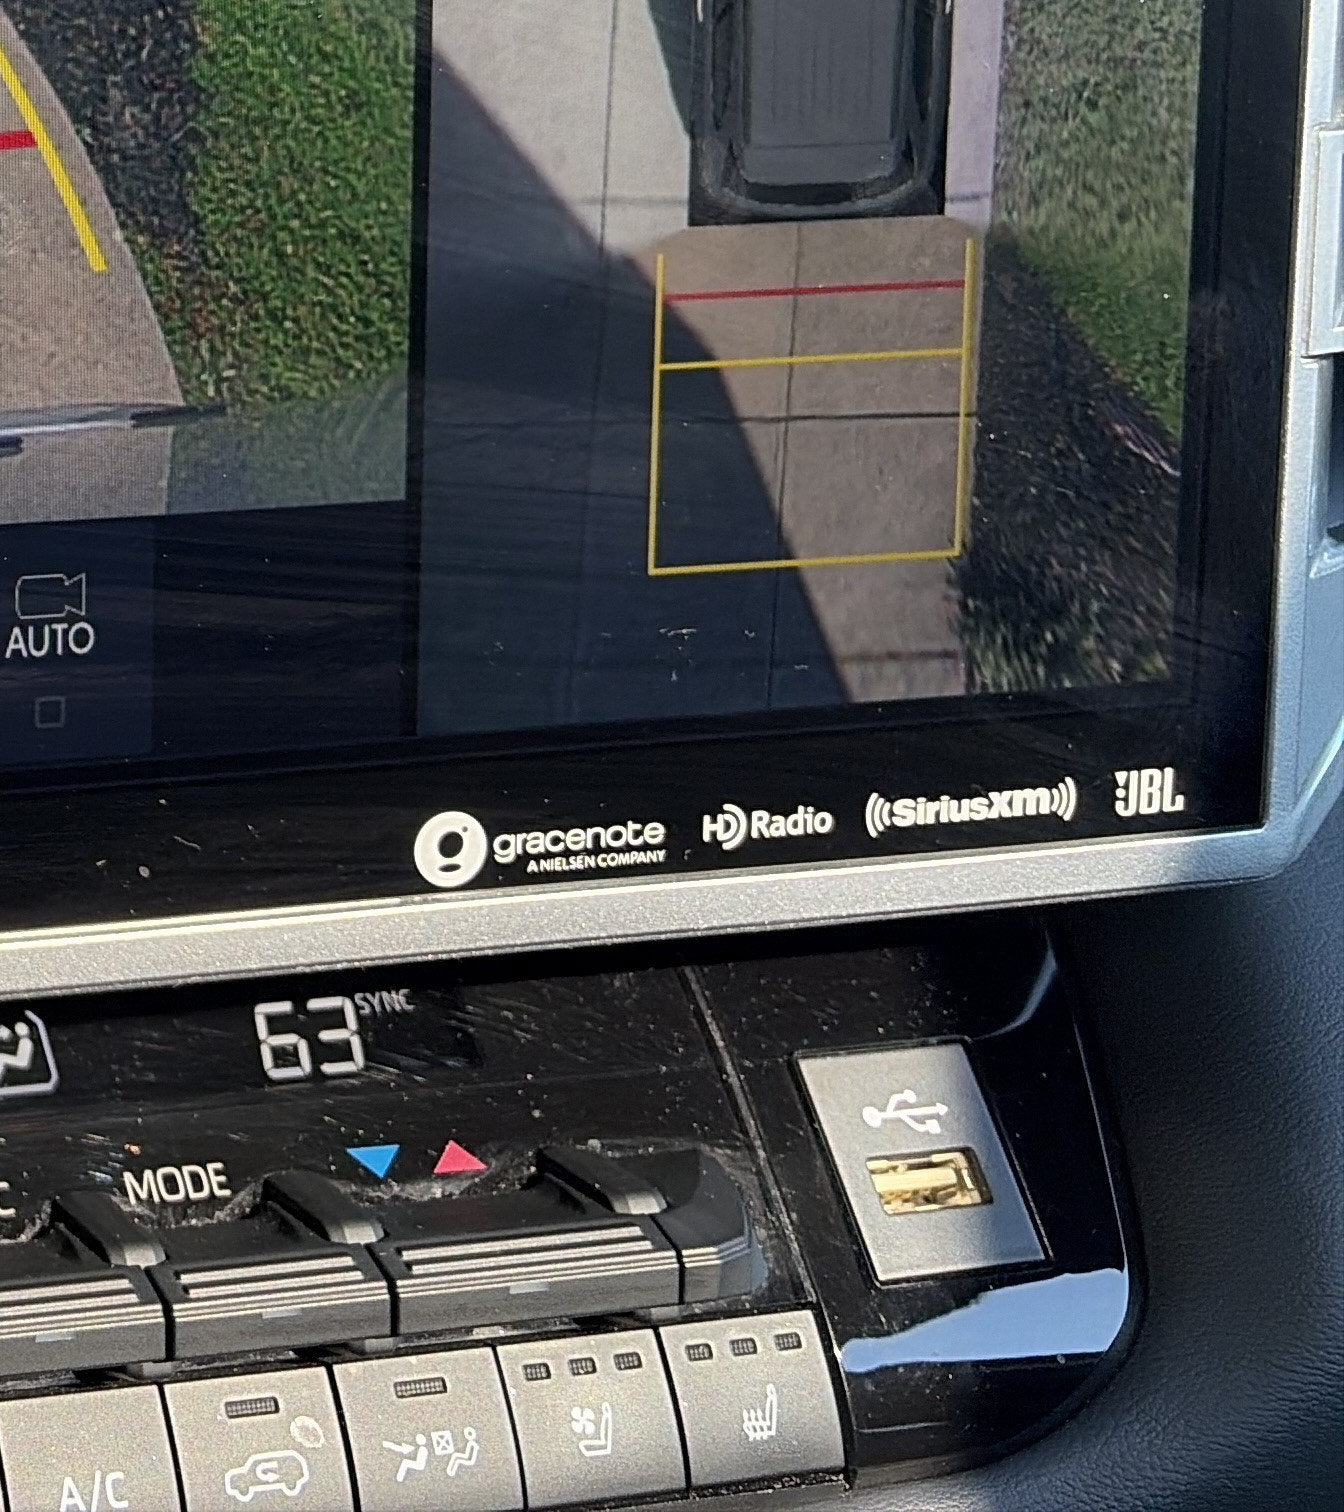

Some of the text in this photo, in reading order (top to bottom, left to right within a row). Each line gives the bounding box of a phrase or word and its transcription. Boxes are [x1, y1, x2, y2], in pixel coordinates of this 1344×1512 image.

[5, 622, 97, 659] AUTO
[1114, 767, 1185, 817] JBL
[493, 820, 666, 864] gracenote
[750, 806, 834, 840] Radio
[526, 848, 668, 873] A NIELSEN COMPANY
[254, 989, 416, 1081] 63 SYNC
[122, 1162, 233, 1205] MODE
[59, 1469, 131, 1512] A/C
